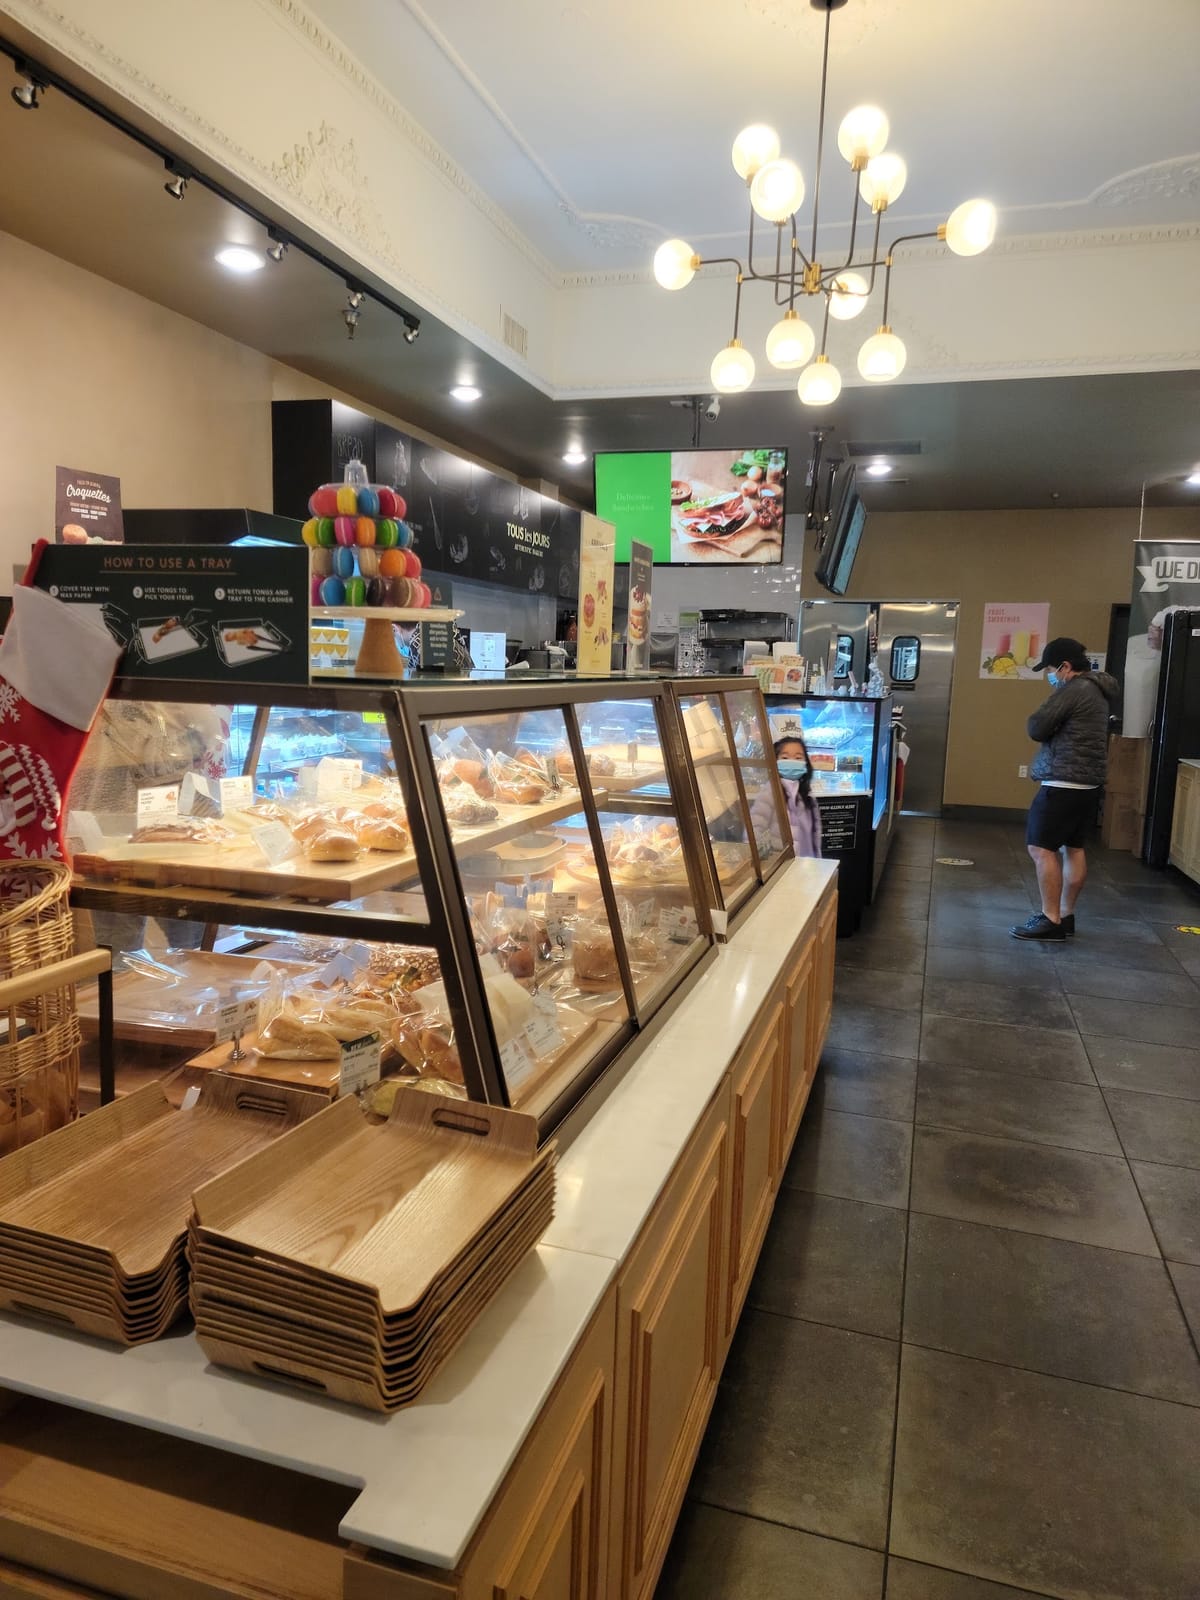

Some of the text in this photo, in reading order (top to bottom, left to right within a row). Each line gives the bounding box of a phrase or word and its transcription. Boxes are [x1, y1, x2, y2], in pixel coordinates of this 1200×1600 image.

[66, 484, 112, 503] Croquettes
[506, 522, 524, 540] TOUS
[531, 531, 550, 549] JOURS
[104, 557, 233, 569] HOW TO USE A TRAY
[1155, 560, 1200, 579] WE D
